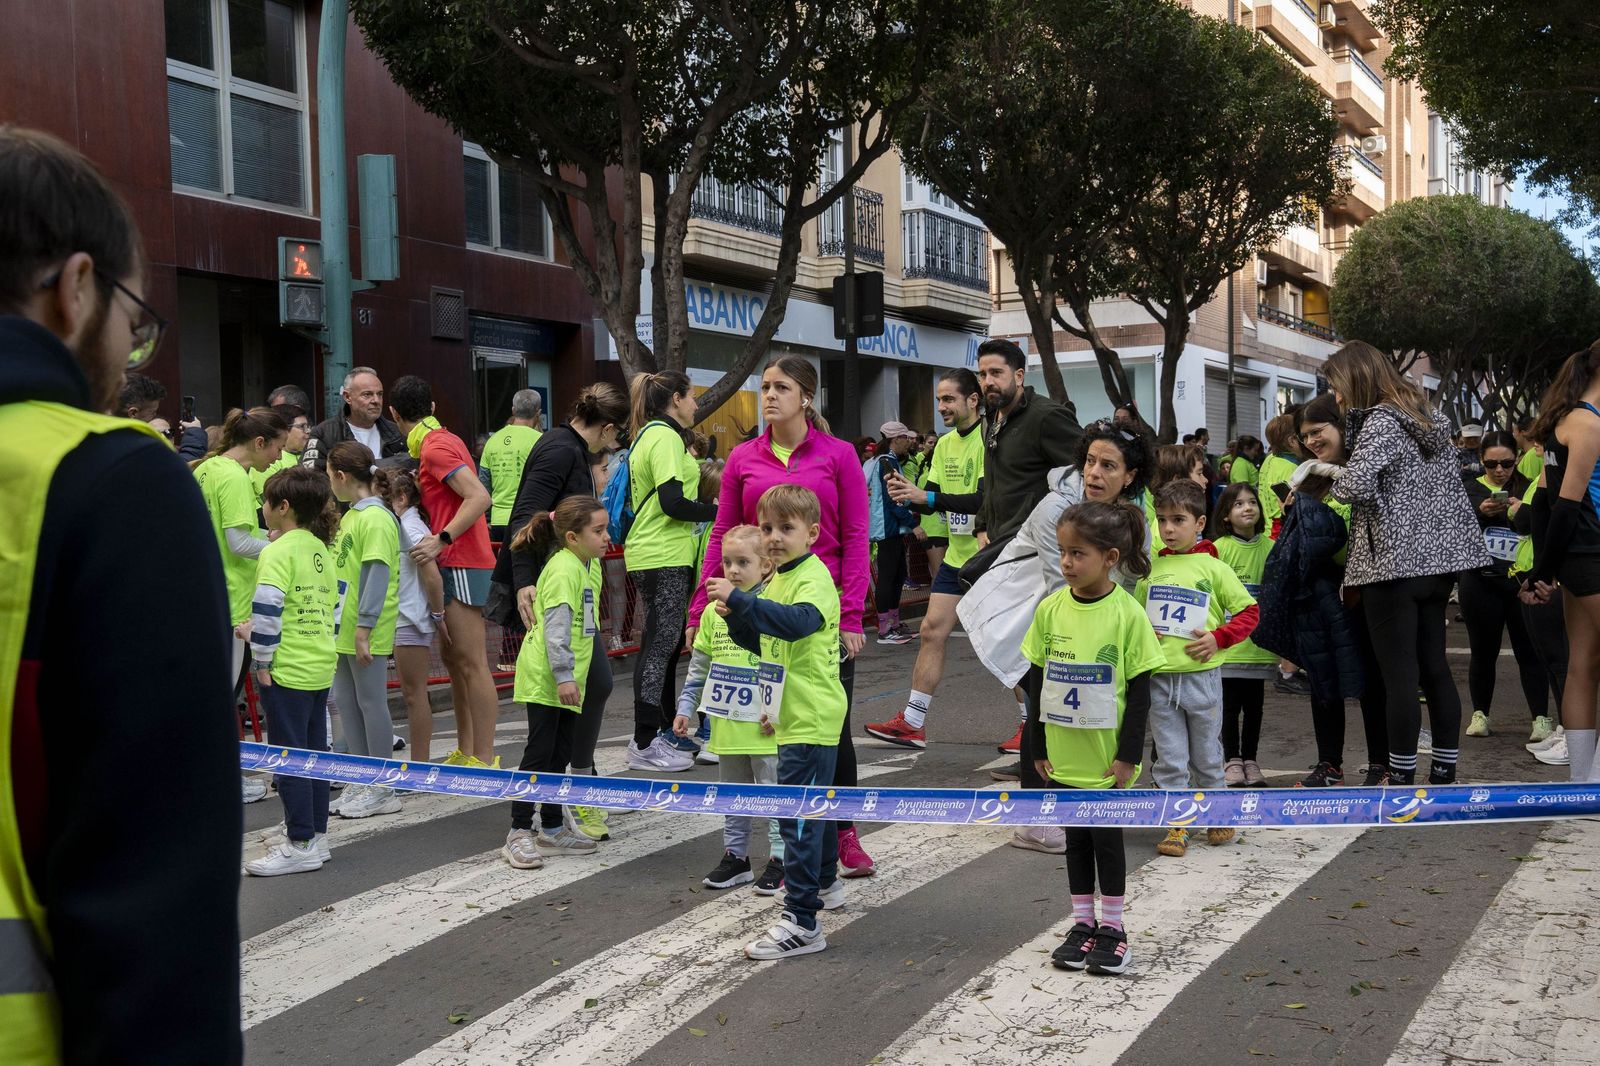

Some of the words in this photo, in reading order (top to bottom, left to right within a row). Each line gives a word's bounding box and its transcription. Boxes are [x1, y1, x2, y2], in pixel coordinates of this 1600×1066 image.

[686, 284, 779, 336] ABANC
[358, 308, 373, 325] 81
[841, 322, 919, 358] ANCA
[951, 513, 968, 525] 569
[1487, 538, 1519, 552] 117
[1159, 603, 1187, 624] 14
[711, 683, 753, 706] 579
[1063, 687, 1081, 710] 4
[586, 786, 643, 798] Ayuntamiento
[734, 794, 796, 806] Ayuntamiento
[896, 800, 966, 811] Ayuntamiento
[1078, 801, 1156, 811] Ayuntamiento
[743, 804, 779, 812] Almería
[910, 809, 948, 817] Almería
[1077, 810, 1090, 818] de
[1093, 810, 1136, 818] Almería
[1282, 808, 1298, 816] de
[1300, 806, 1350, 815] Almería
[1460, 804, 1496, 813] ALMERÍA
